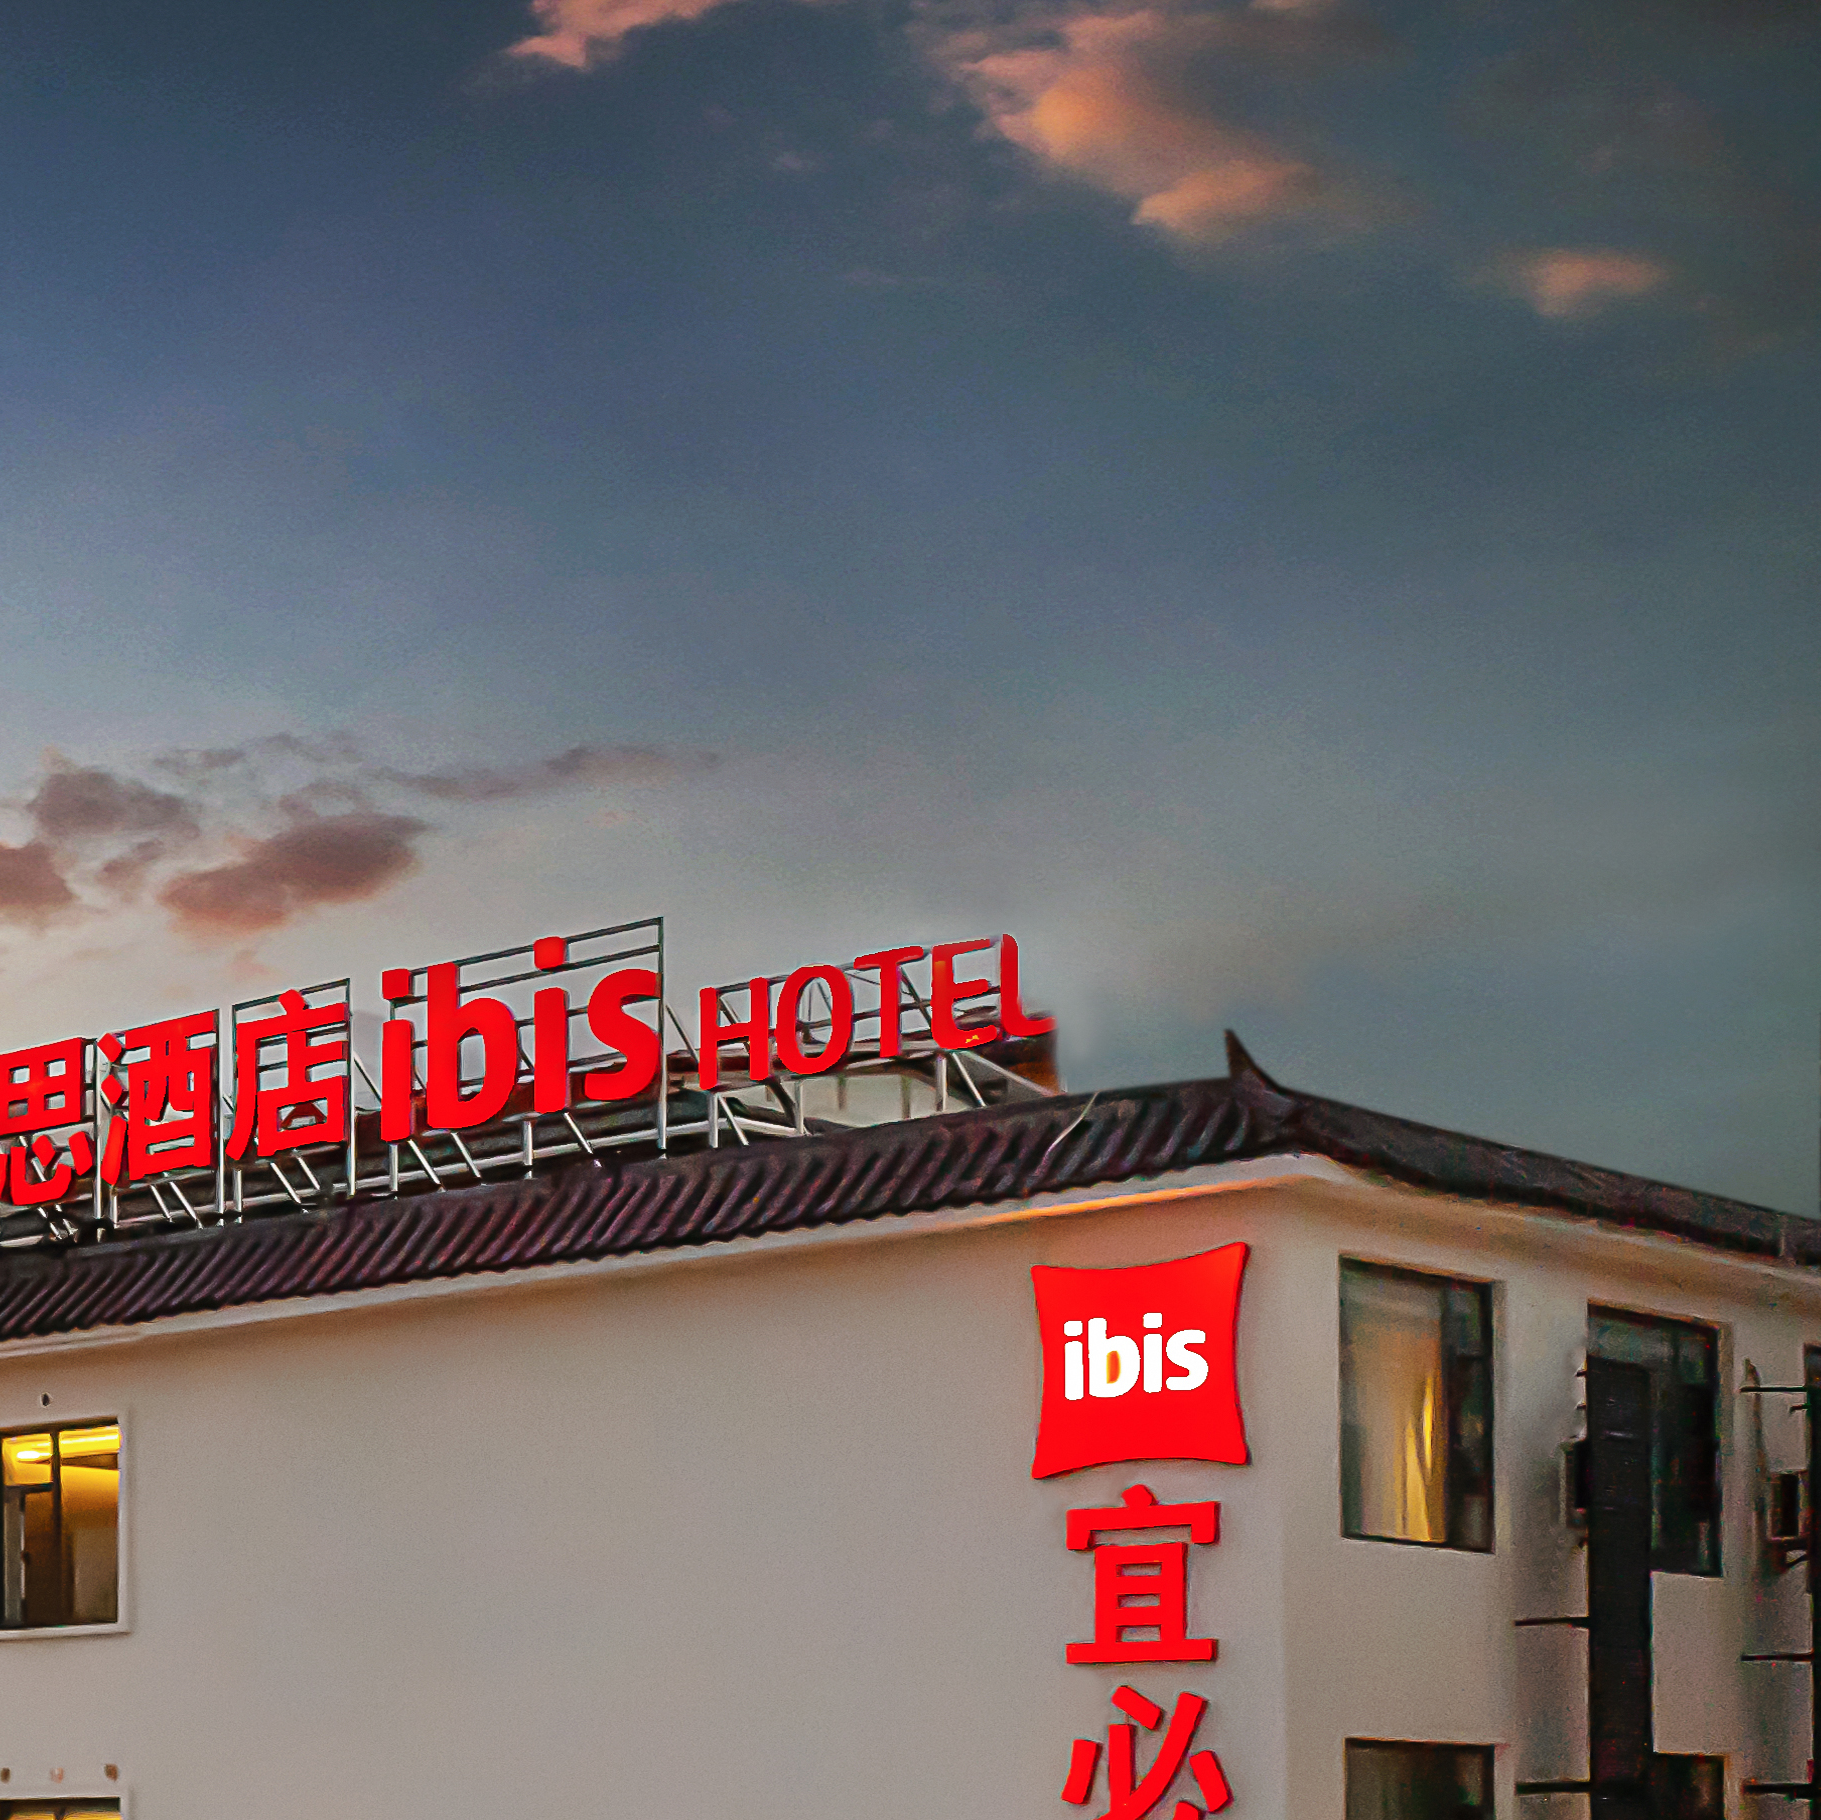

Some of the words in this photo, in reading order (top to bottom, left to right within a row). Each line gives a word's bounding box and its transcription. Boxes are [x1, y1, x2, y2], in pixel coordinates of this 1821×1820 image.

[379, 936, 662, 1143] ibis
[698, 933, 1058, 1089] HOTEL
[1063, 1312, 1209, 1401] ibis
